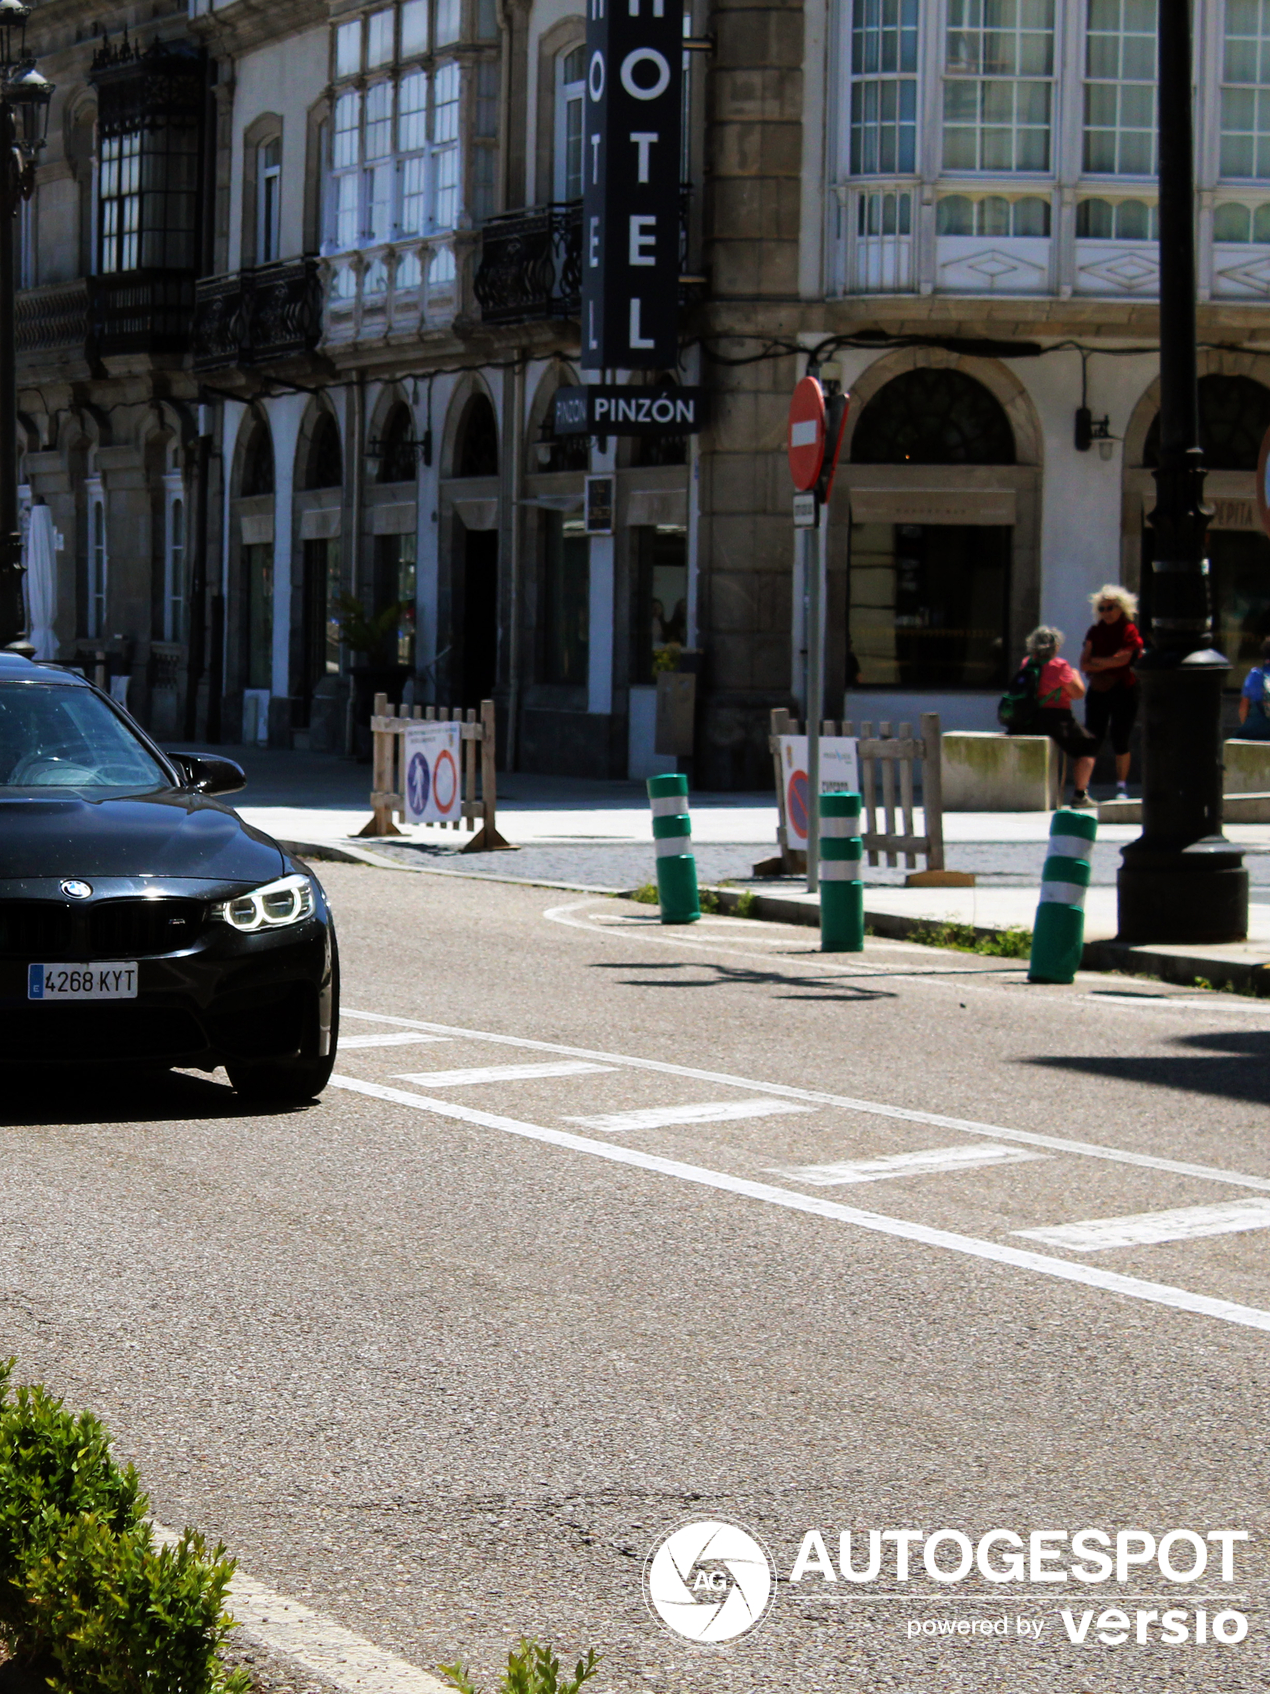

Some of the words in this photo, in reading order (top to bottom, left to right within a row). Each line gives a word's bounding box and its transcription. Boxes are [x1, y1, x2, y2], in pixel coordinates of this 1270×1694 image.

[594, 391, 695, 423] PINZÓN
[45, 971, 94, 993] 4268
[99, 969, 135, 992] KYT
